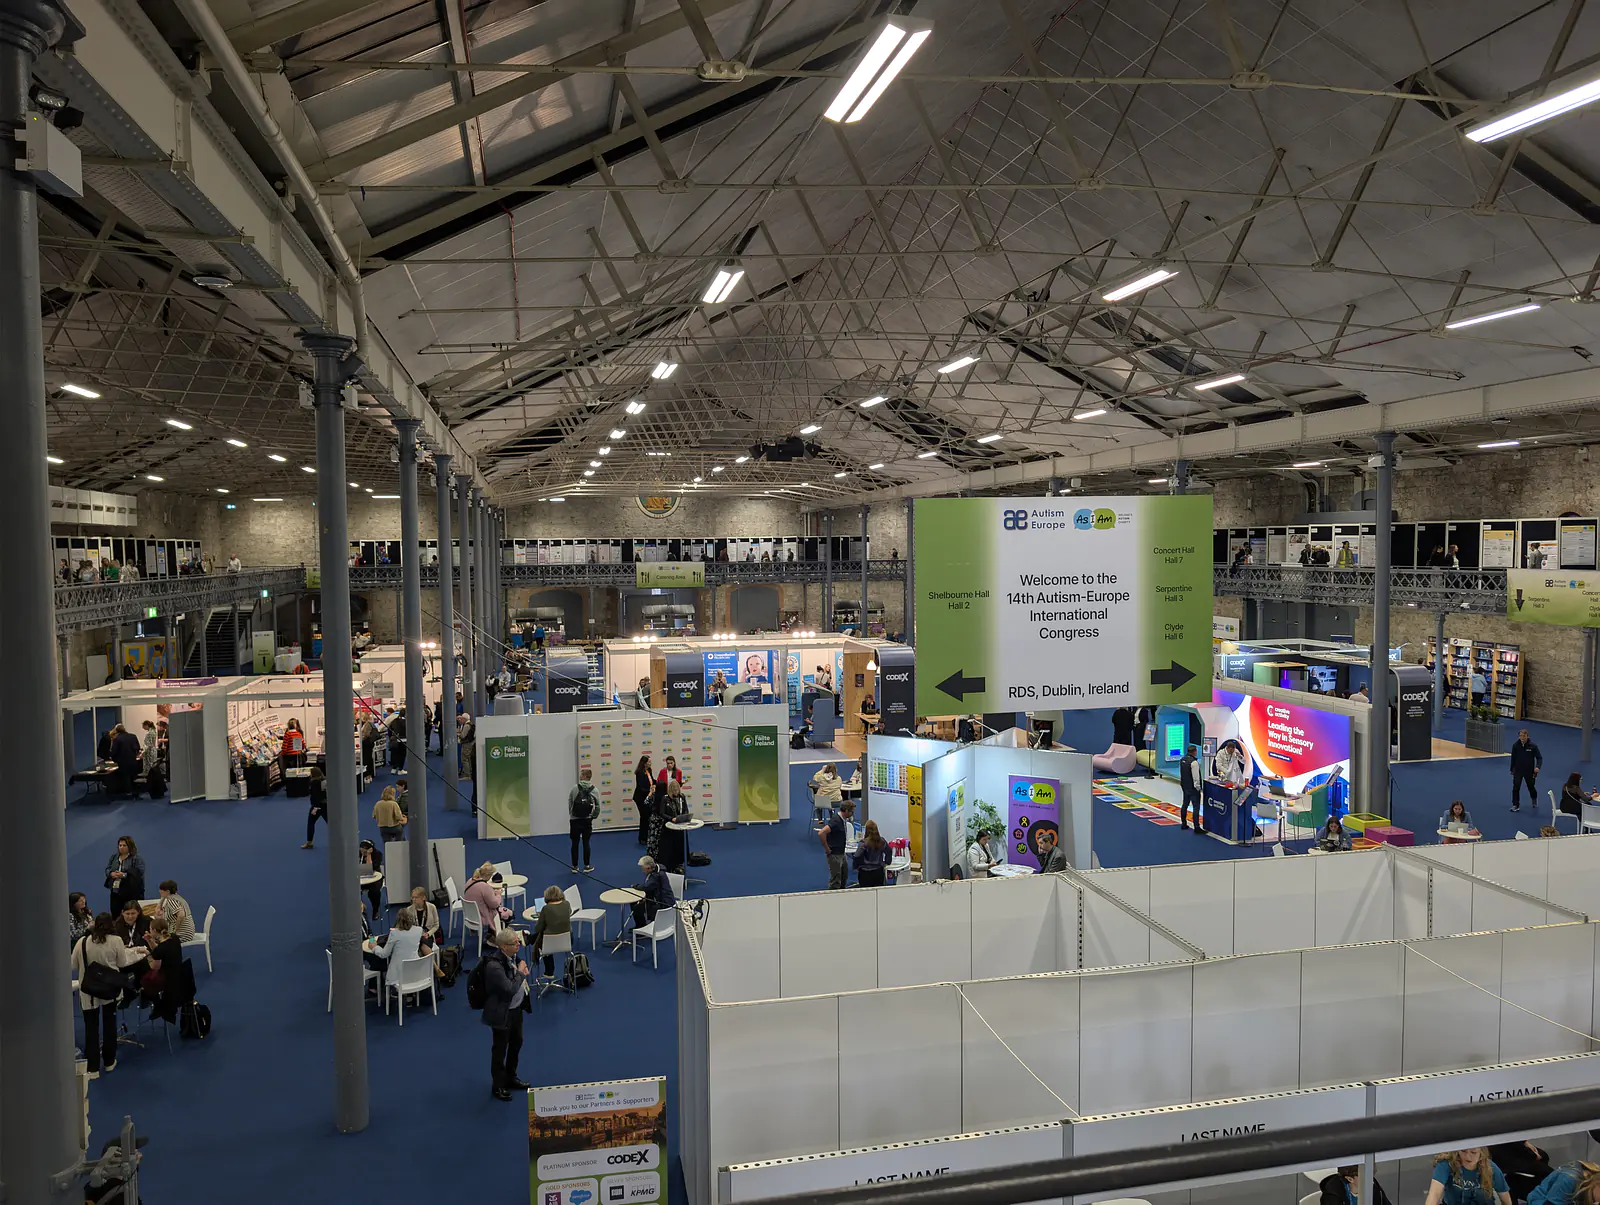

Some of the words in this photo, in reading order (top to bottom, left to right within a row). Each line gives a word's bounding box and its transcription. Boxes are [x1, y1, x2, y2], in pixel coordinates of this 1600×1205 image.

[1031, 509, 1065, 518] Autism
[1031, 521, 1066, 531] Europe
[1182, 546, 1195, 554] Hall
[1164, 556, 1178, 564] Hall
[1179, 556, 1184, 564] 7
[1020, 574, 1079, 586] Welcome
[1081, 573, 1094, 585] to
[1097, 572, 1118, 584] the
[1155, 585, 1193, 594] Serpentine
[928, 591, 974, 600] Shelbourne
[975, 590, 990, 598] Hall
[1006, 592, 1034, 604] 14th
[1036, 590, 1130, 604] Autism-Europe
[949, 602, 963, 610] Hall
[964, 601, 970, 609] 2
[1030, 608, 1108, 622] International
[1164, 623, 1184, 632] Clyde
[1039, 627, 1100, 641] Congress
[1164, 633, 1178, 641] Hall
[1179, 632, 1184, 640] 6
[886, 672, 909, 682] CODEX
[673, 680, 698, 690] CODEX
[554, 685, 581, 696] CODEX
[1008, 685, 1039, 700] RDS,
[1042, 684, 1085, 698] Dublin,
[1088, 681, 1129, 695] Ireland
[1402, 690, 1429, 703] CODEX
[1268, 720, 1293, 734] Leading
[1293, 726, 1304, 737] the
[1268, 729, 1282, 742] Way
[1282, 732, 1288, 742] in
[1288, 735, 1314, 751] Sensory
[1268, 738, 1303, 756] Innovation!
[1506, 1085, 1544, 1099] NAME
[622, 1096, 655, 1105] Supporters
[1222, 1123, 1266, 1137] NAME
[607, 1149, 650, 1166] CODEX
[543, 1162, 570, 1171] PLATINUM
[571, 1159, 598, 1167] SPONSOR
[562, 1181, 591, 1190] SPONSORS
[630, 1187, 655, 1197] KPMG
